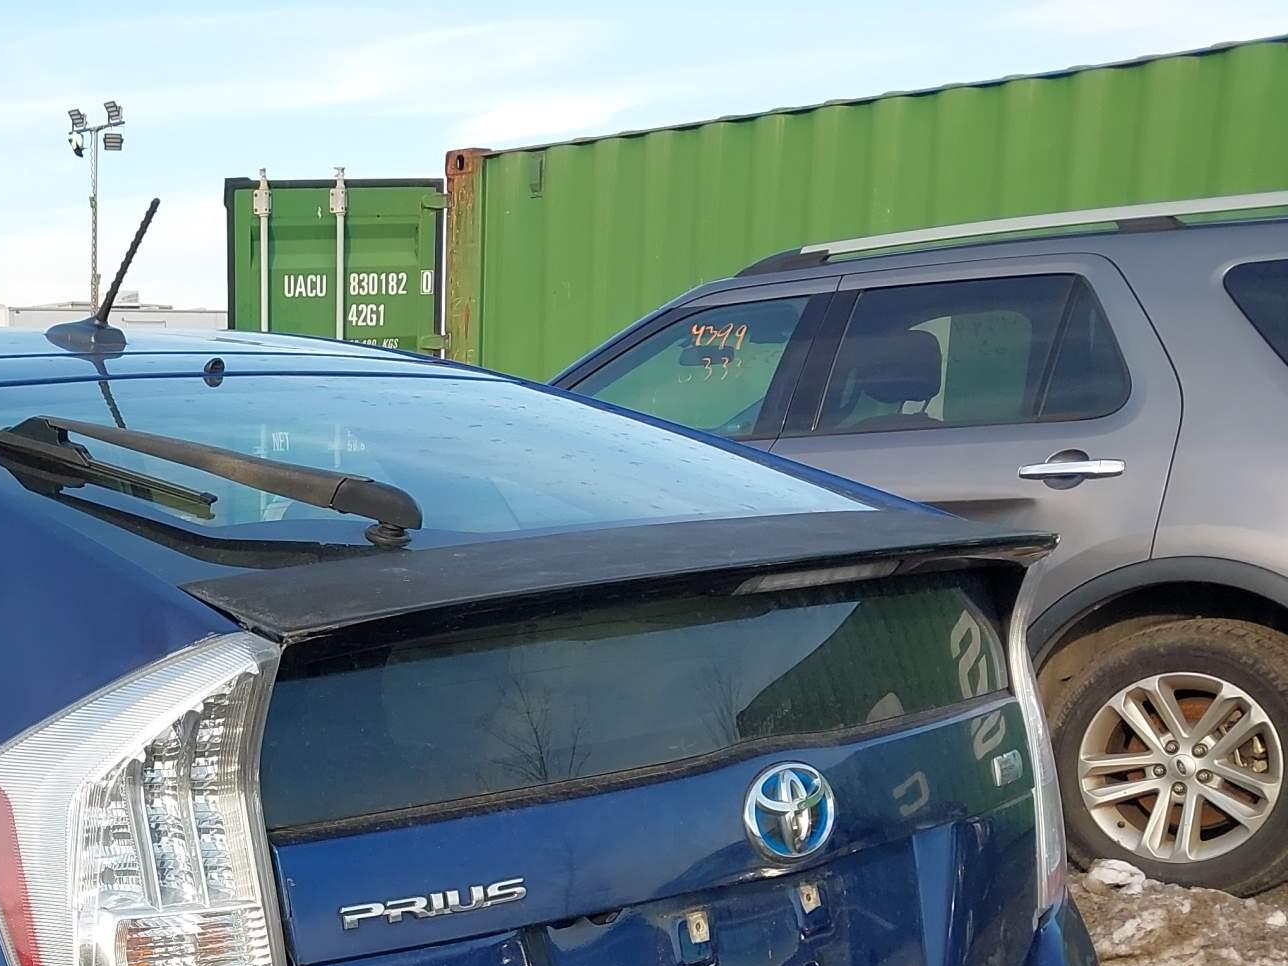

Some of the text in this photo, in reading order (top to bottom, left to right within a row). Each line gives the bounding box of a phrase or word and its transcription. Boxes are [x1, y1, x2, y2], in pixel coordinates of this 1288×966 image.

[284, 271, 432, 297] UACU 830182 0
[348, 303, 385, 326] 42G1
[382, 338, 399, 349] KGS
[339, 877, 527, 930] PRIUS
